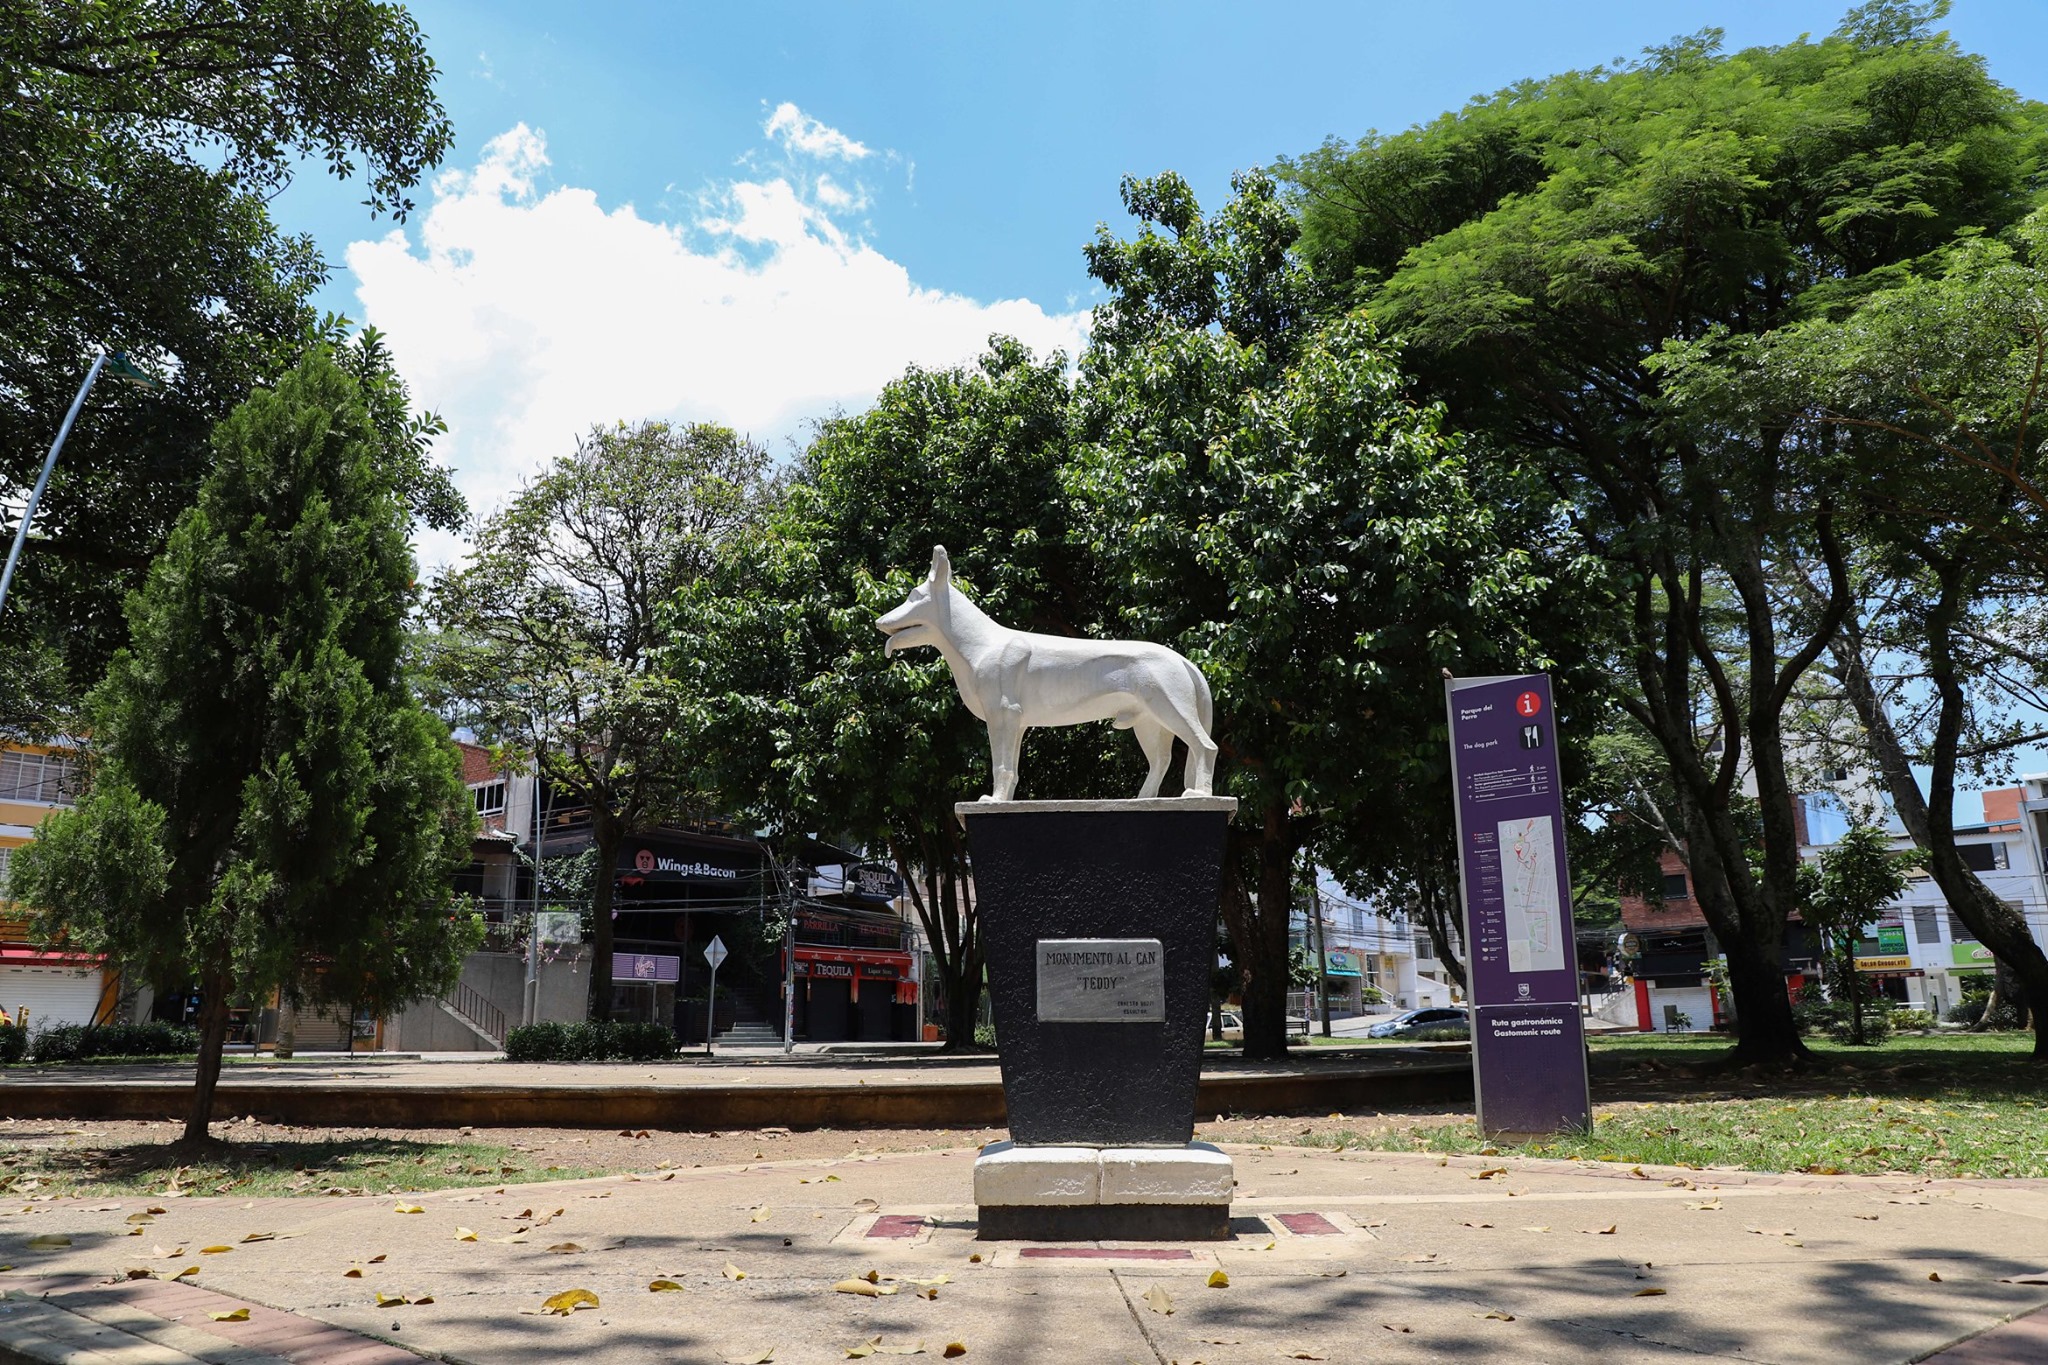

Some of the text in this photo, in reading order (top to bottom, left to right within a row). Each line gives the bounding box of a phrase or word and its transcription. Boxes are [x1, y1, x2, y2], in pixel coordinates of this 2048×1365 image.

[1461, 707, 1482, 715] Parque
[1474, 741, 1485, 749] dog
[1486, 738, 1498, 748] park
[657, 857, 737, 879] Wings&Bacon
[858, 868, 896, 885] TEQUILA
[803, 919, 839, 932] PARRILLA
[1045, 951, 1156, 966] MONUMENTO AL CAN
[815, 963, 853, 977] TEQUILA
[1076, 976, 1125, 991] "TEDDY"
[1511, 1017, 1563, 1027] gastronómica
[1493, 1027, 1539, 1037] Gastomonic
